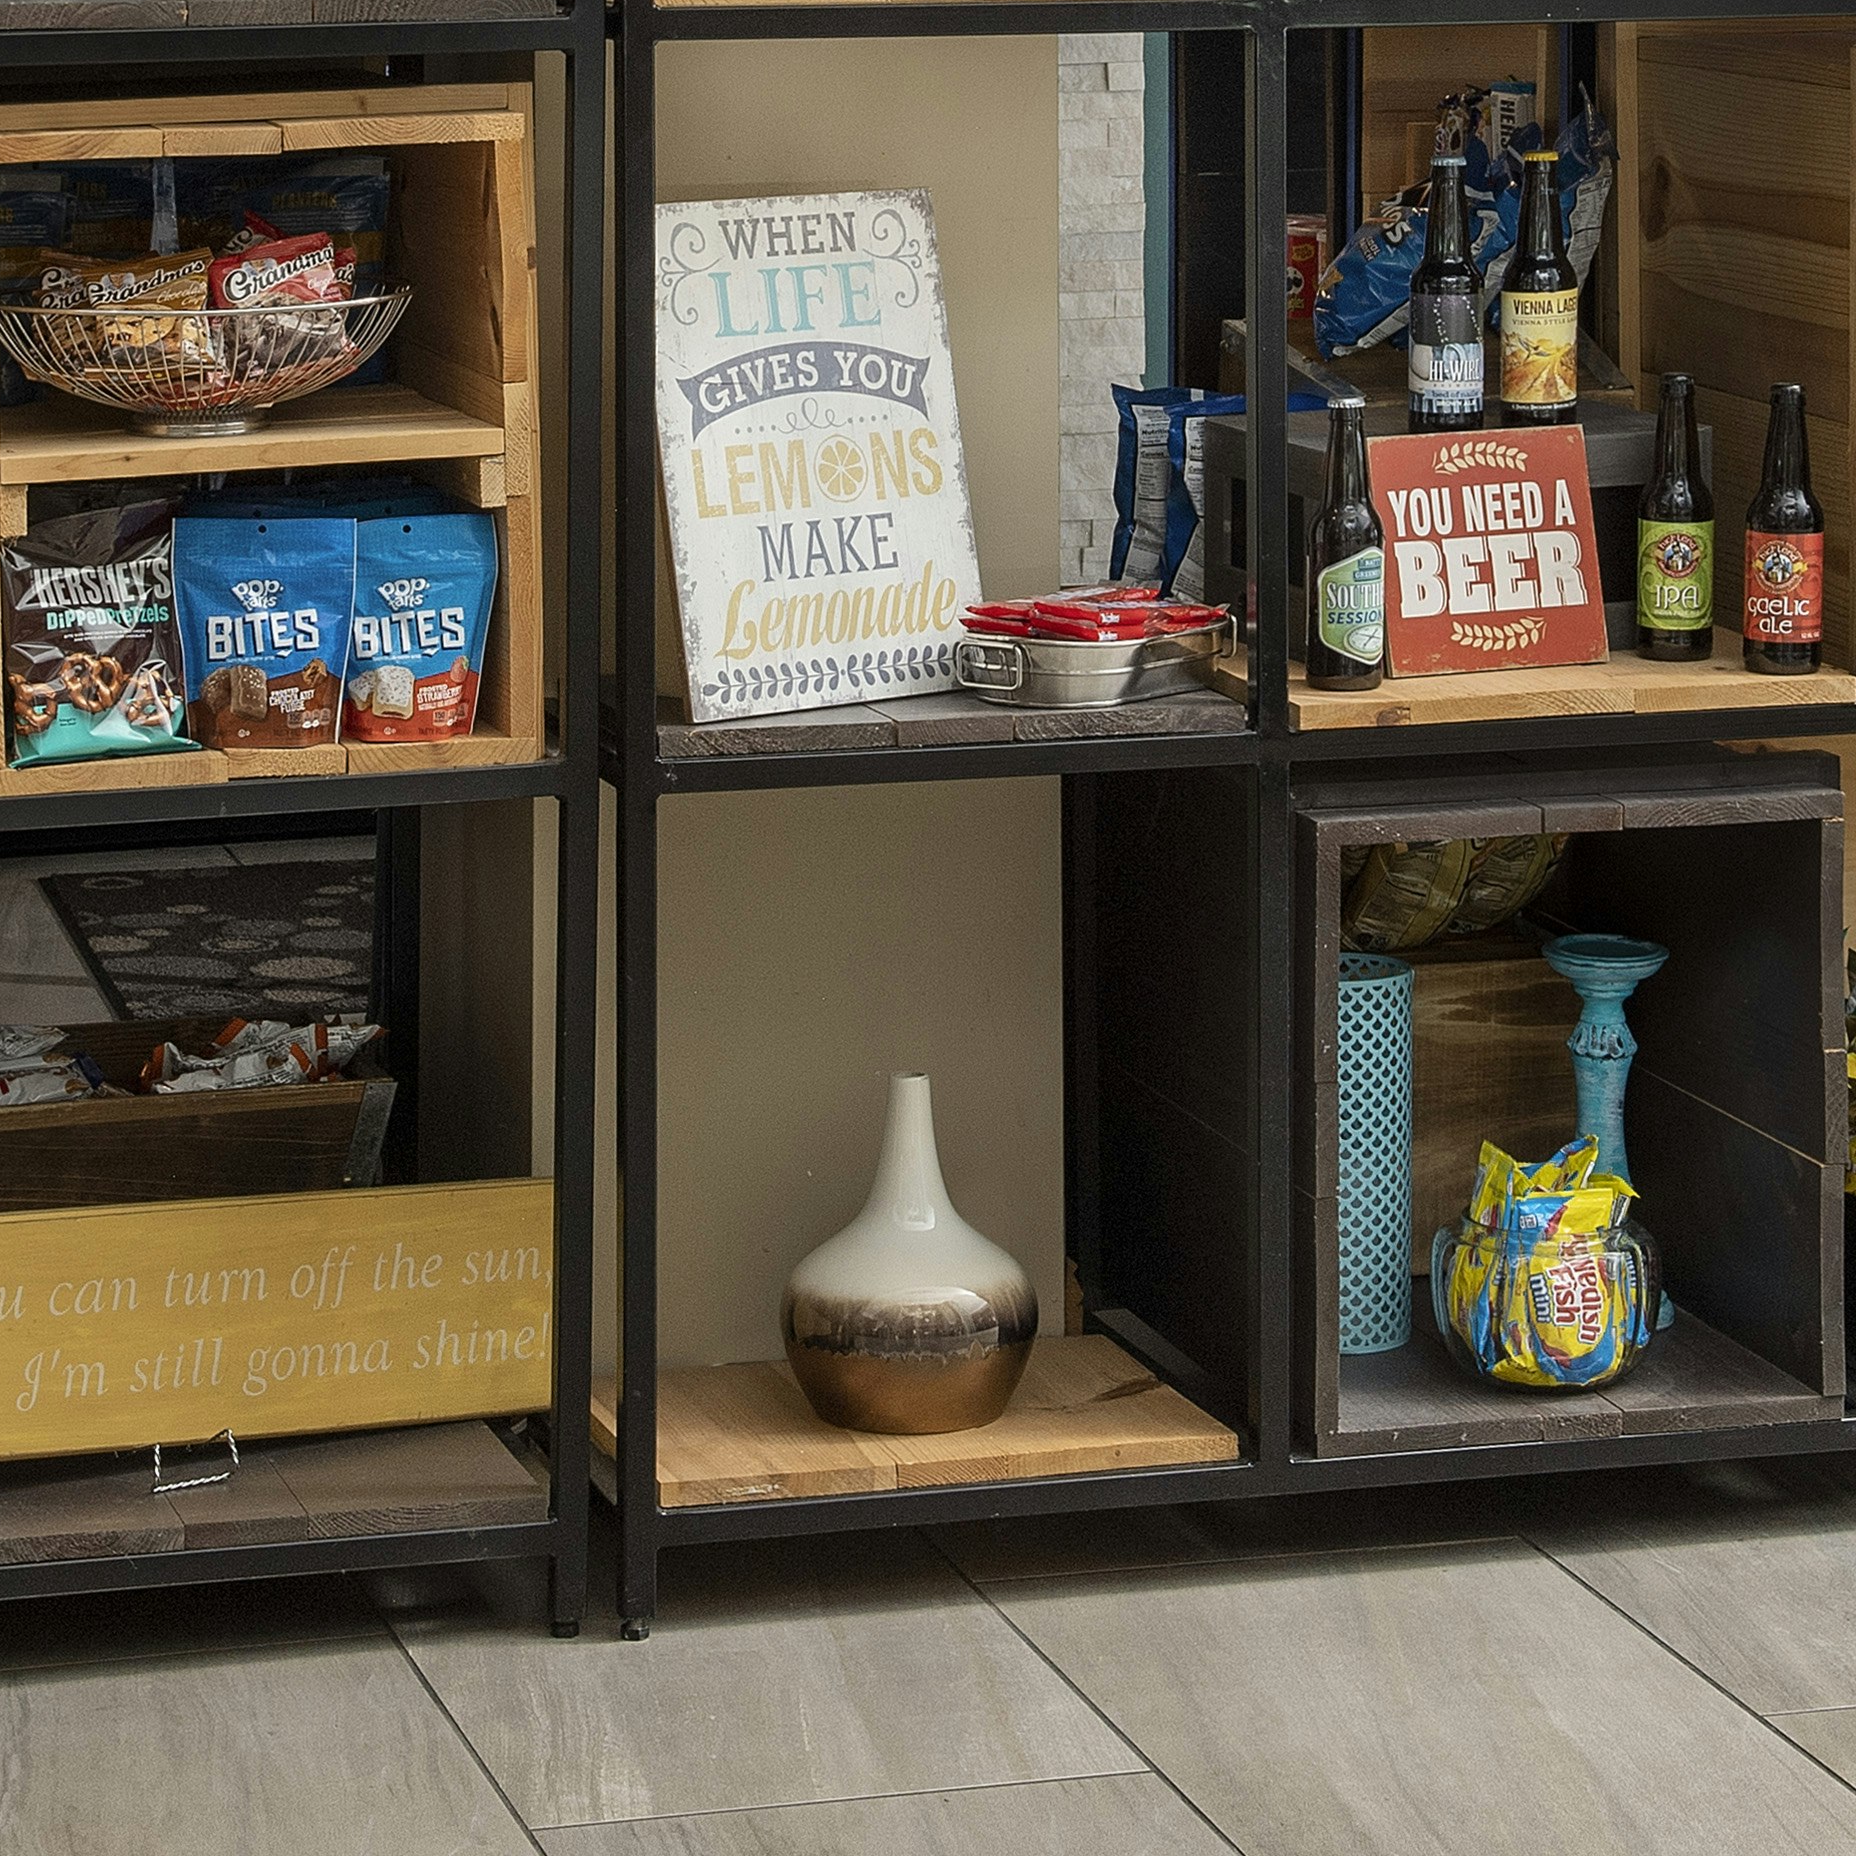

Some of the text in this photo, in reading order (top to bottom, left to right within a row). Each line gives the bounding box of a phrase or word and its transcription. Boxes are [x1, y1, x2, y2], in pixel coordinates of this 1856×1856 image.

[717, 211, 857, 262] WHEN
[86, 259, 206, 307] Grandma's
[707, 259, 882, 339] LIFE
[1513, 298, 1554, 317] VIENNA
[1512, 318, 1542, 326] VIENNA
[697, 351, 917, 414] GIVES YOU
[1428, 357, 1481, 381] HI-WIRE
[1386, 478, 1576, 538] YOU NEED A
[756, 512, 899, 582] MAKE
[30, 556, 172, 610] HERSHEY'S
[1393, 530, 1589, 620] BEER
[1654, 584, 1700, 610] IPA
[206, 608, 320, 660] BITES
[351, 608, 465, 660] BITES
[712, 559, 958, 661] Lemonade
[49, 1275, 139, 1315] can
[162, 1265, 270, 1310] turn
[290, 1246, 355, 1310] off
[371, 1242, 444, 1294] the
[461, 1242, 553, 1289] sun,
[1530, 1272, 1552, 1324] mini
[1548, 1264, 1580, 1326] Fish
[14, 1312, 550, 1414] I'm still gonna shine!
